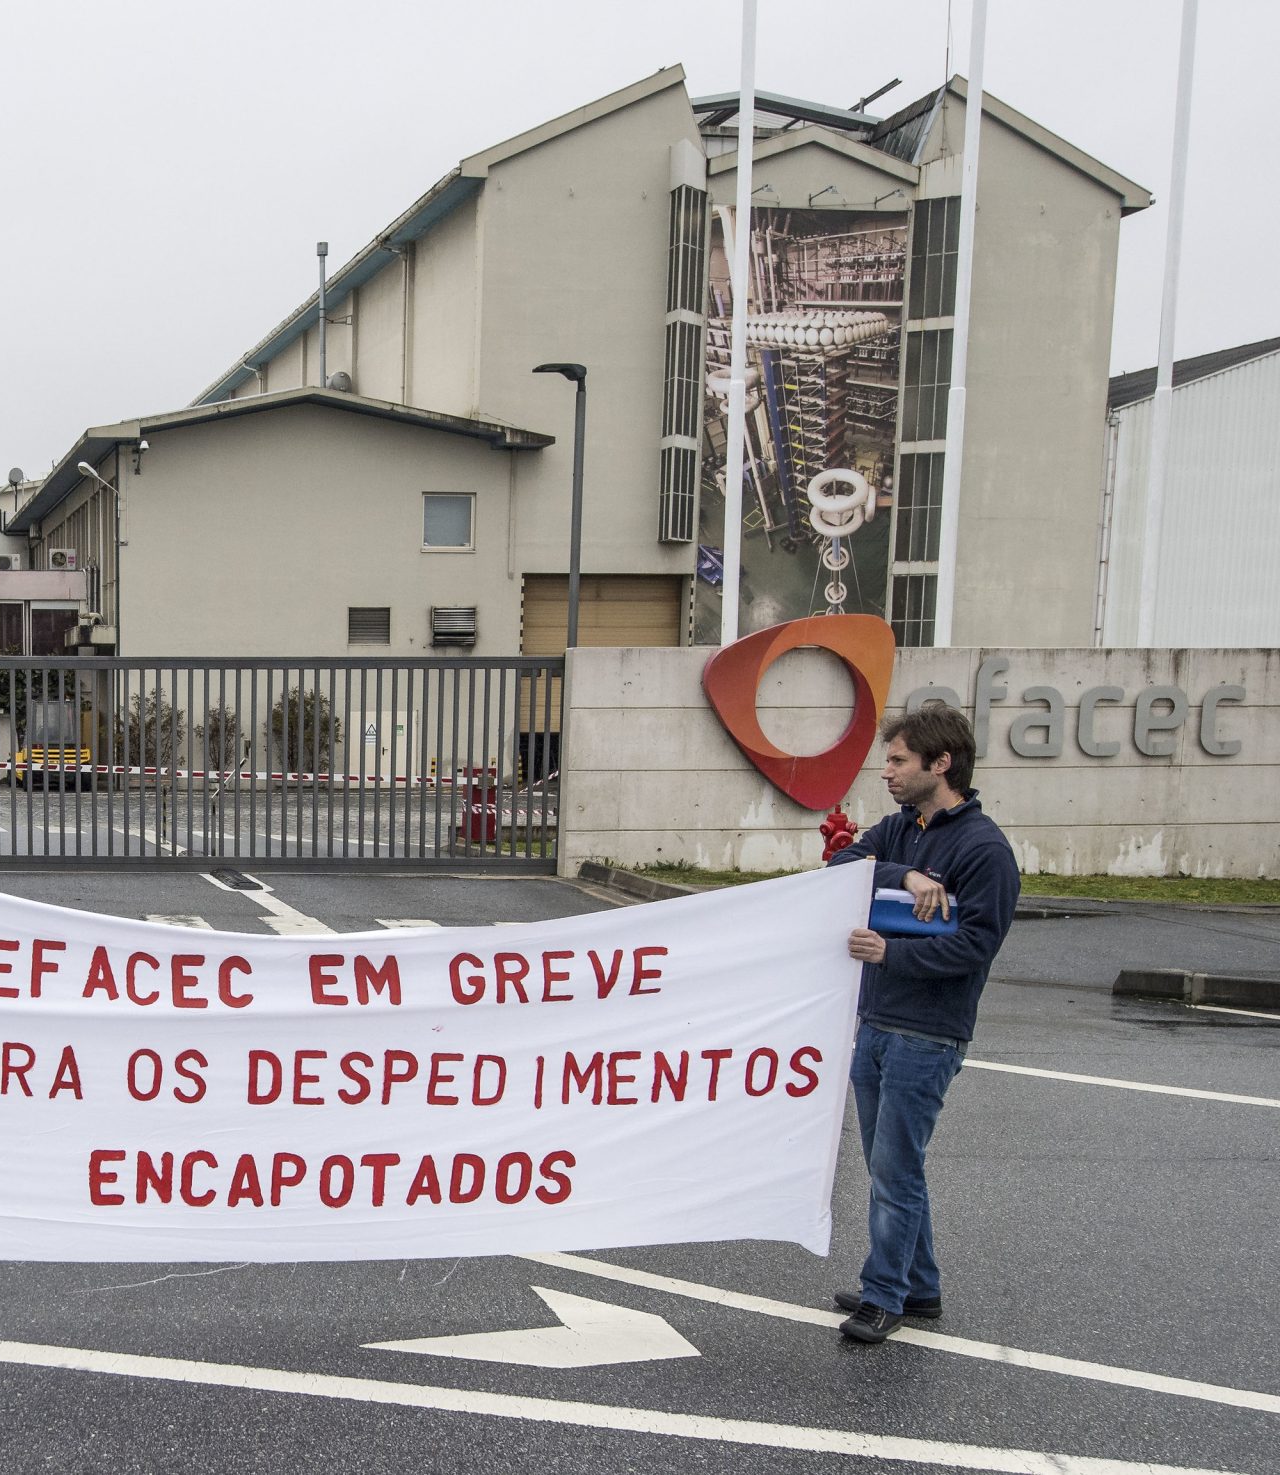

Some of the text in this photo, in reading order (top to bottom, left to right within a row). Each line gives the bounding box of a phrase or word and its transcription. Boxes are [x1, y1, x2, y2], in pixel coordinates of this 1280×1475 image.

[310, 955, 401, 1006] EM
[450, 947, 668, 1005] GREVE
[128, 1049, 208, 1104] OS
[247, 1047, 823, 1109] DESPEDIMENTOS
[89, 1150, 576, 1209] ENCAPOTADOS
